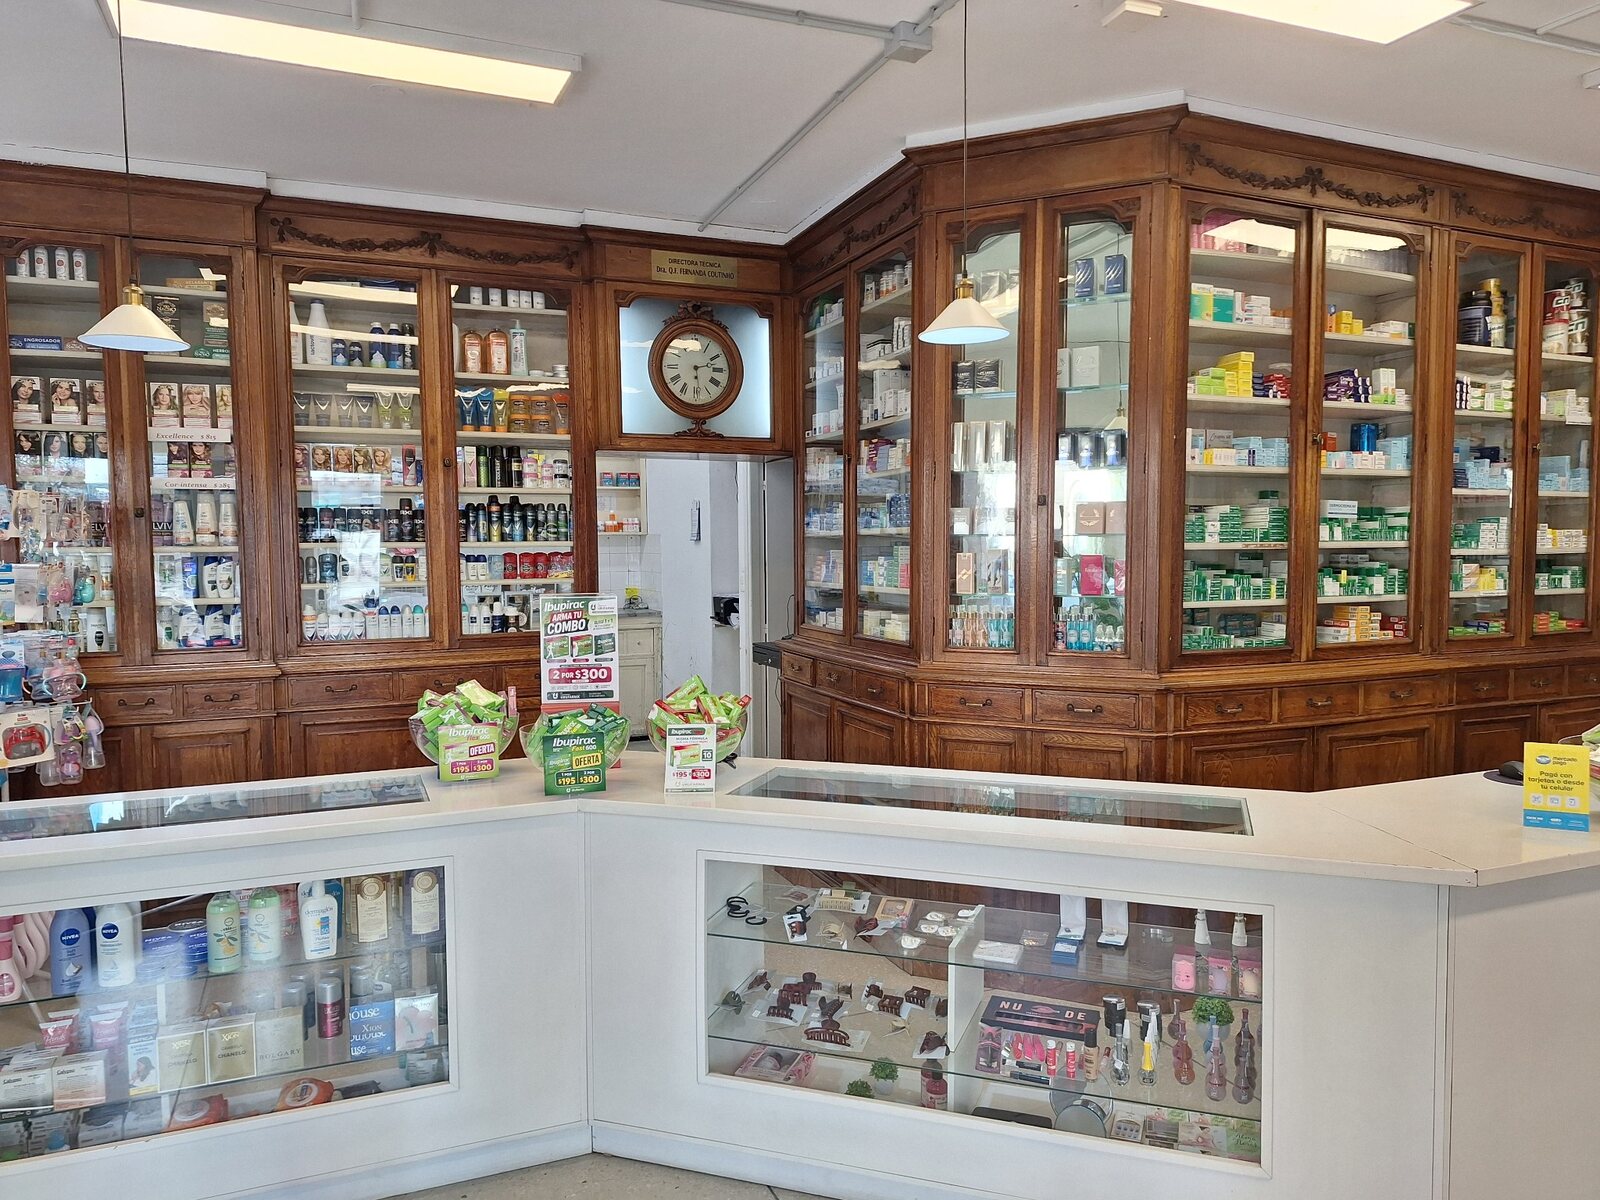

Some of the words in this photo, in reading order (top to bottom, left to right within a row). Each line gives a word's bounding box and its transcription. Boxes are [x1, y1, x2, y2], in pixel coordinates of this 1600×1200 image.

[668, 258, 699, 266] DIRECTORA
[679, 267, 707, 277] FERNANDA
[707, 270, 735, 280] COUTINHO
[156, 432, 194, 440] Excellence
[180, 480, 208, 489] intensa
[544, 600, 586, 612] Ibupirac
[552, 612, 572, 622] ARMA
[573, 610, 583, 619] TU
[547, 618, 587, 635] COMBO
[552, 670, 560, 680] 2
[575, 668, 608, 680] $300
[448, 726, 490, 738] Ibupirac
[552, 736, 597, 748] Ibupirac
[469, 743, 496, 756] OFERTA
[702, 751, 712, 759] 10
[574, 754, 600, 767] OFERTA
[452, 765, 470, 773] $195
[473, 763, 492, 772] $300
[557, 776, 576, 785] $195
[579, 774, 600, 784] $300
[174, 919, 204, 927] NIVEA
[61, 933, 80, 941] NIVEA
[999, 1000, 1023, 1011] NU
[1064, 1010, 1087, 1021] DE
